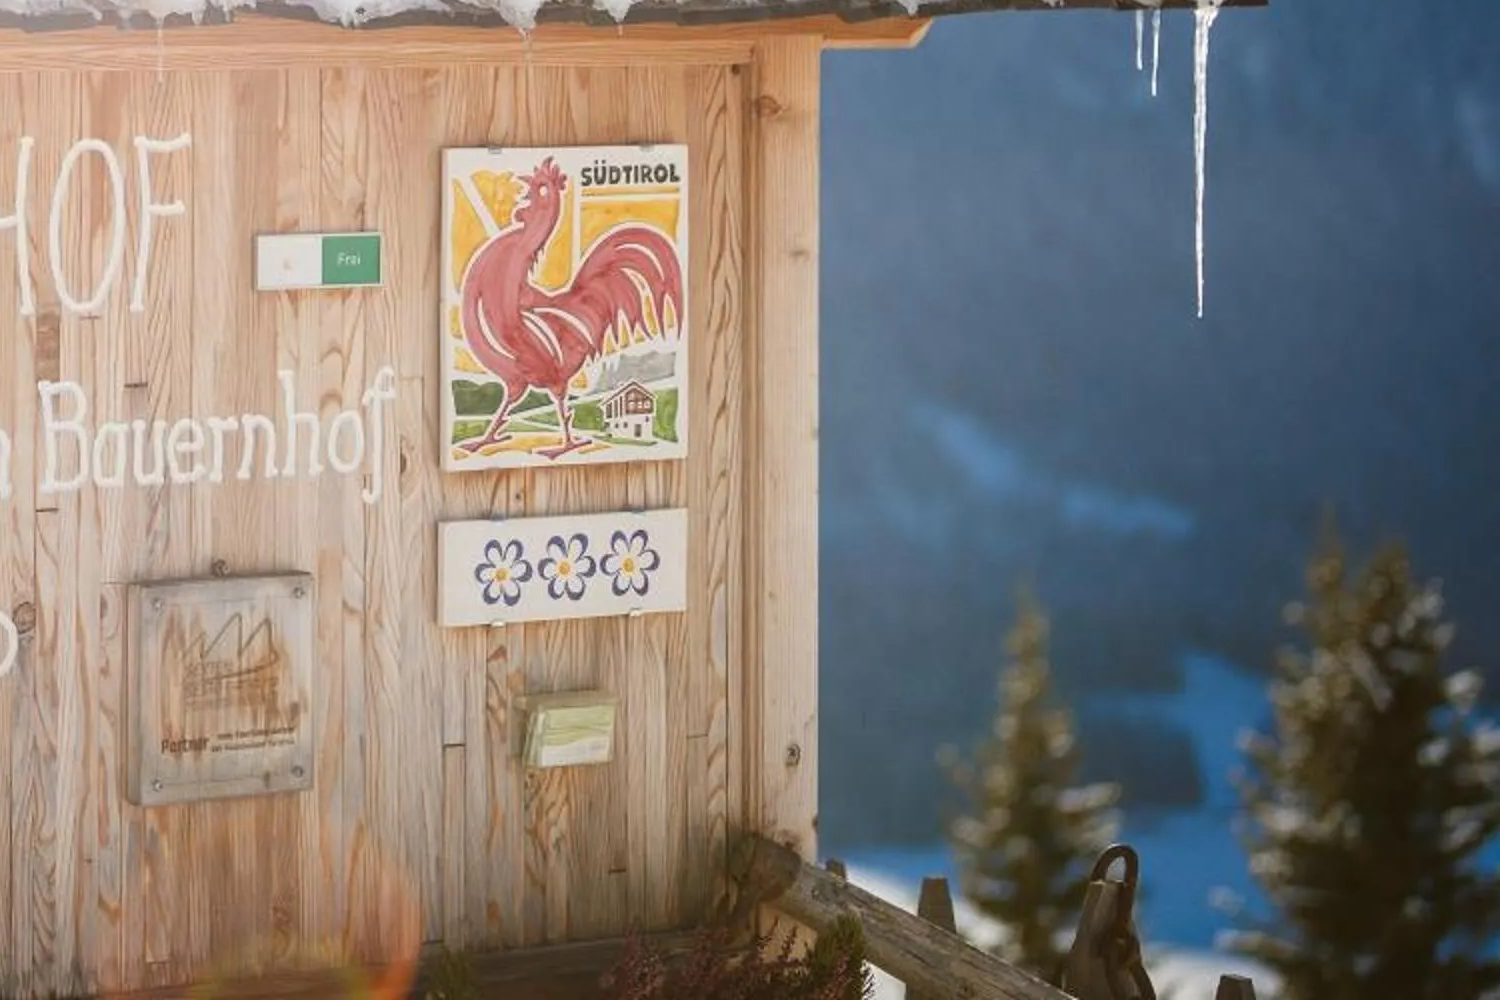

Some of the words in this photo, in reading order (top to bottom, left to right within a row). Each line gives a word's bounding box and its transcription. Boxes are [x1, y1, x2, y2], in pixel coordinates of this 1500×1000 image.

[580, 160, 681, 186] SÜDTIROL
[337, 252, 361, 266] Frei
[36, 366, 396, 505] Bauernhof
